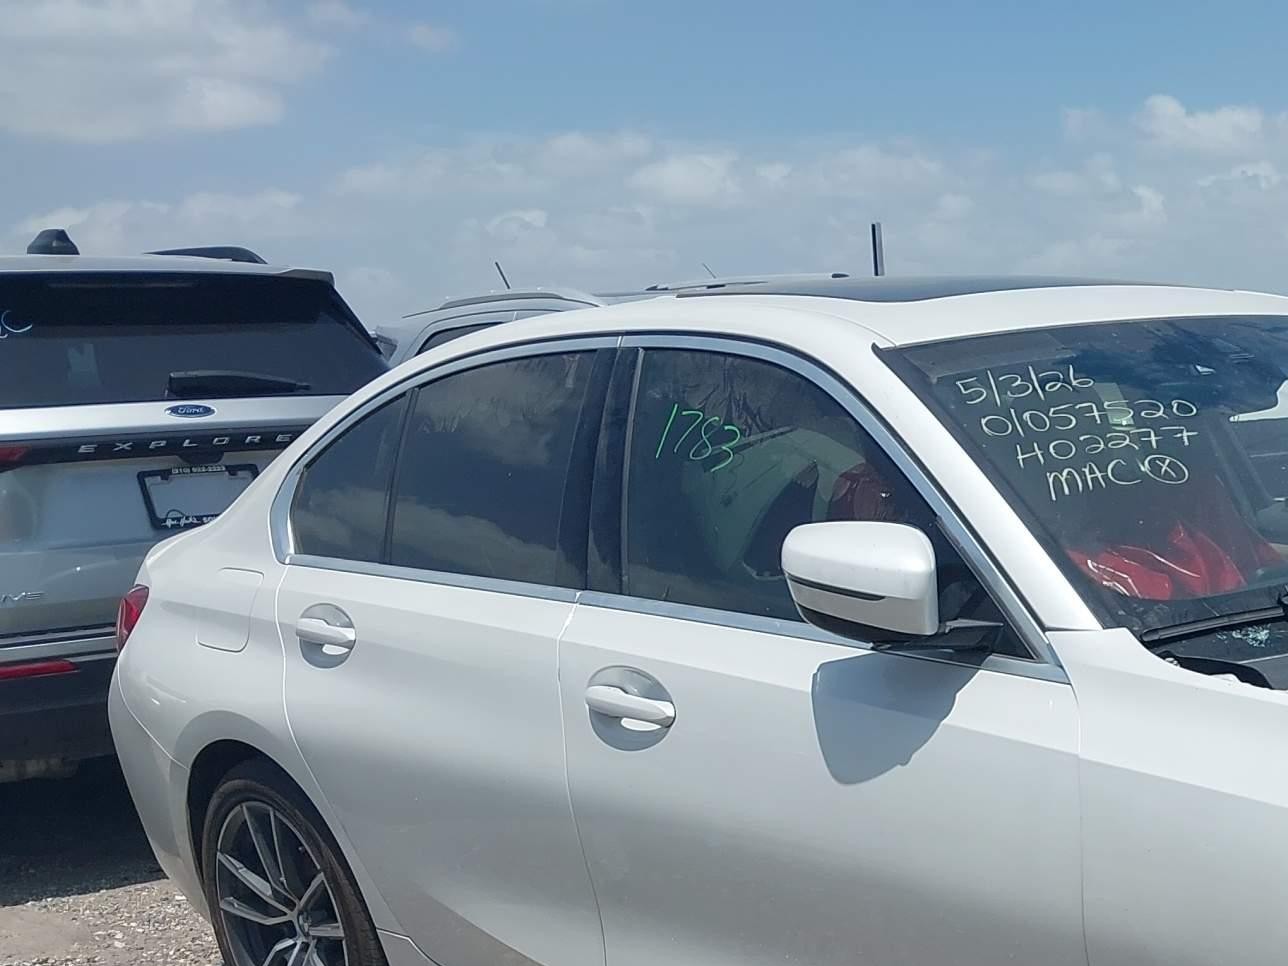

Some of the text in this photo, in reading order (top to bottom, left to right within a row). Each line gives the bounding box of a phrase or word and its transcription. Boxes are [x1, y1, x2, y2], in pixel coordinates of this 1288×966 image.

[956, 365, 1094, 407] 5/3/26
[656, 403, 740, 472] 1783
[981, 400, 1198, 437] 01057520
[1016, 426, 1199, 469] H02277
[1047, 459, 1142, 501] MAC
